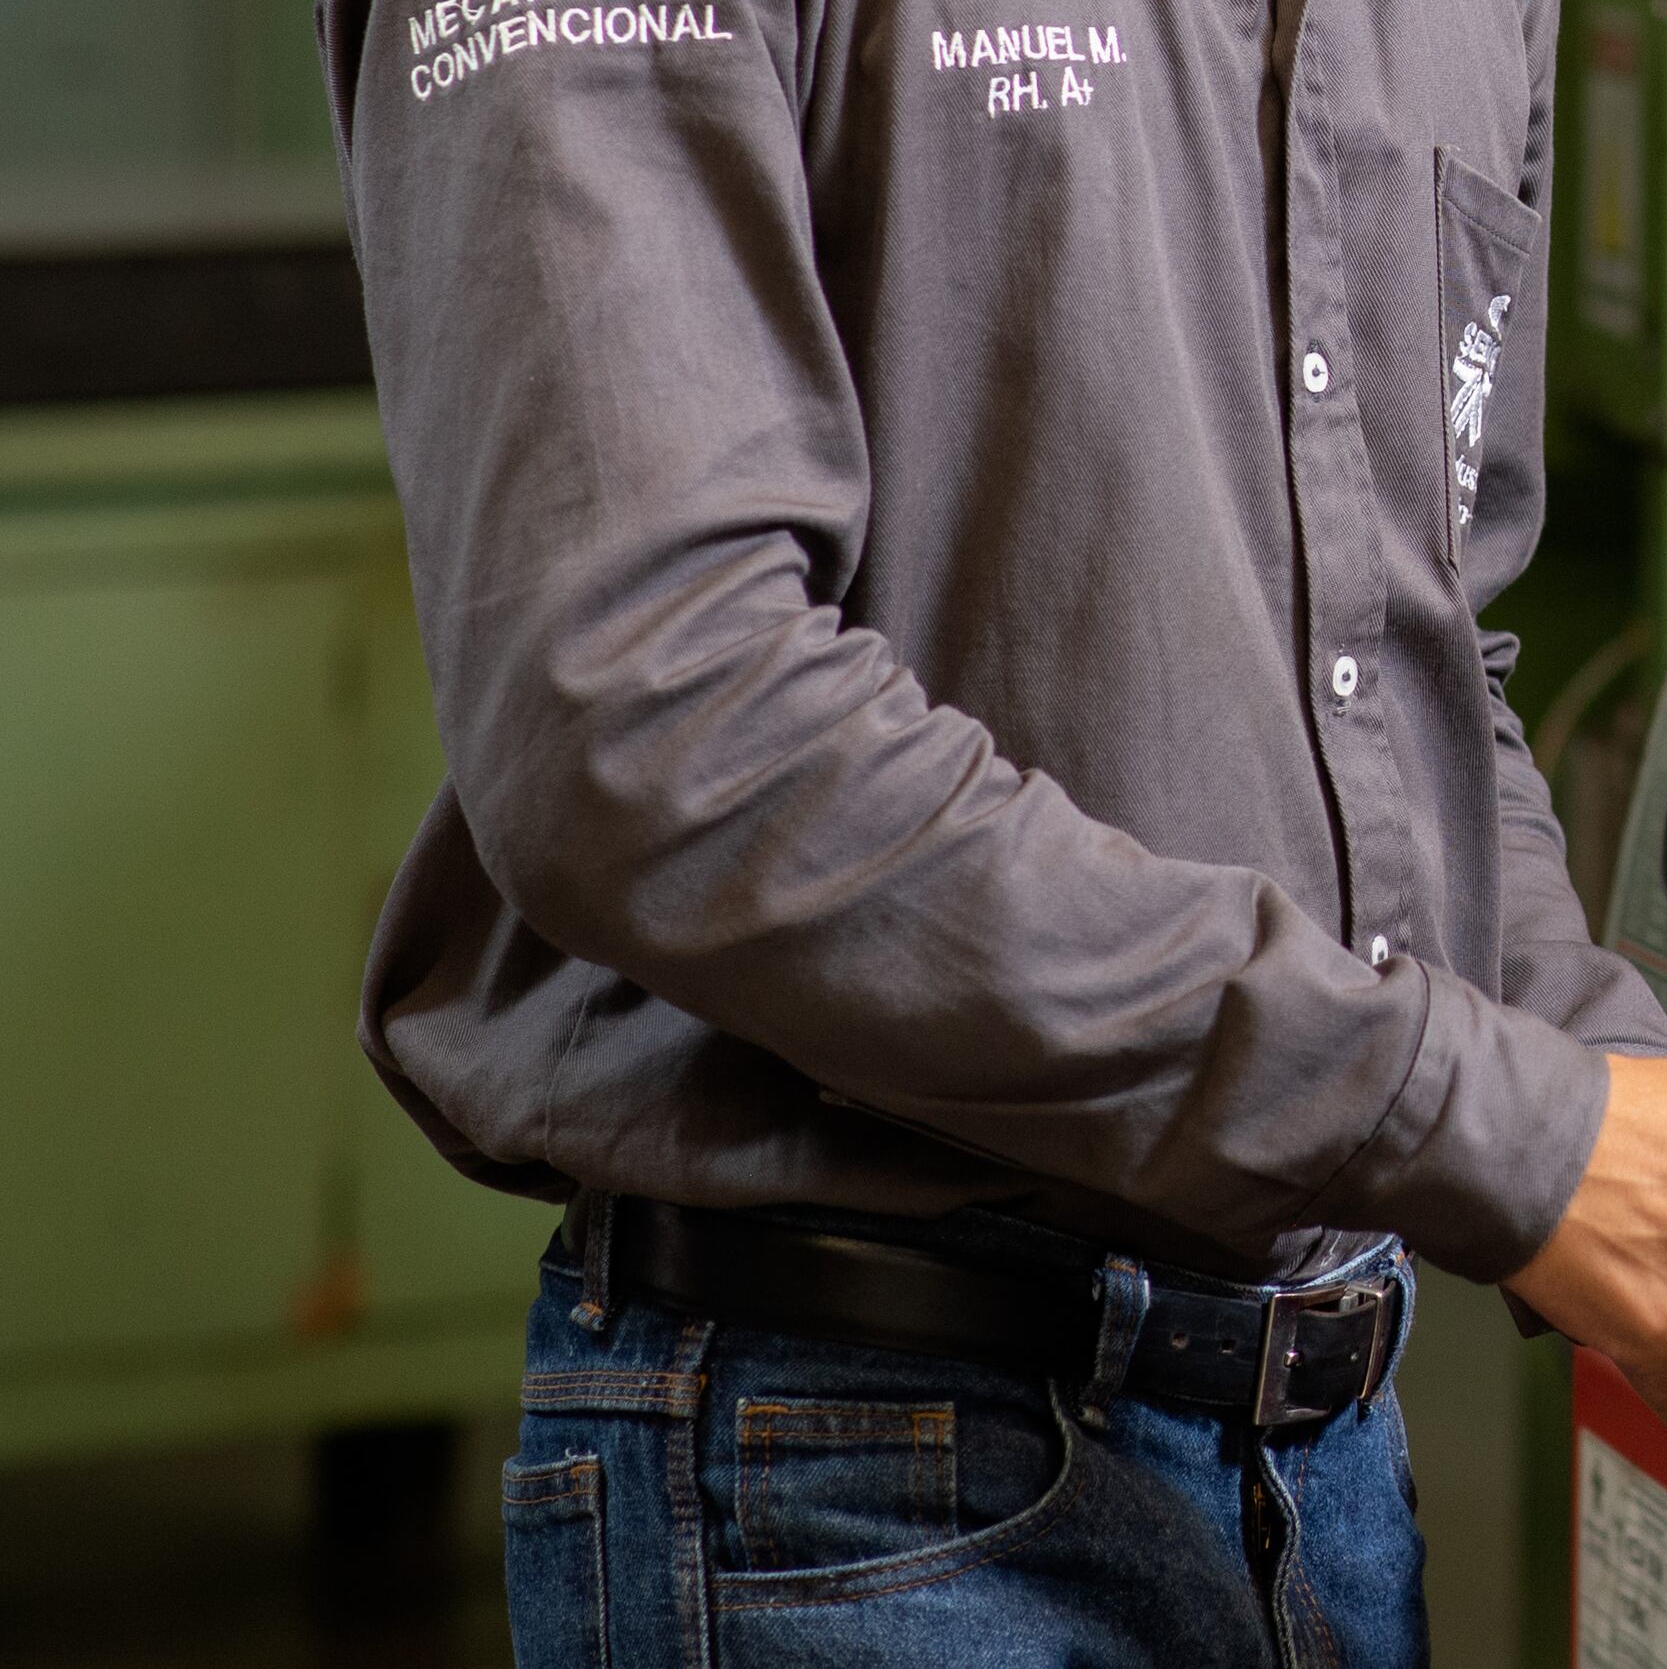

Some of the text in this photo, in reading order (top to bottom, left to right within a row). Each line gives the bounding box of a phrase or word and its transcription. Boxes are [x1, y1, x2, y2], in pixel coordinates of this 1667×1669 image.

[410, 3, 733, 101] CONVENCIONAL
[932, 25, 1127, 70] MANUEL M.
[988, 66, 1094, 119] RH. A+
